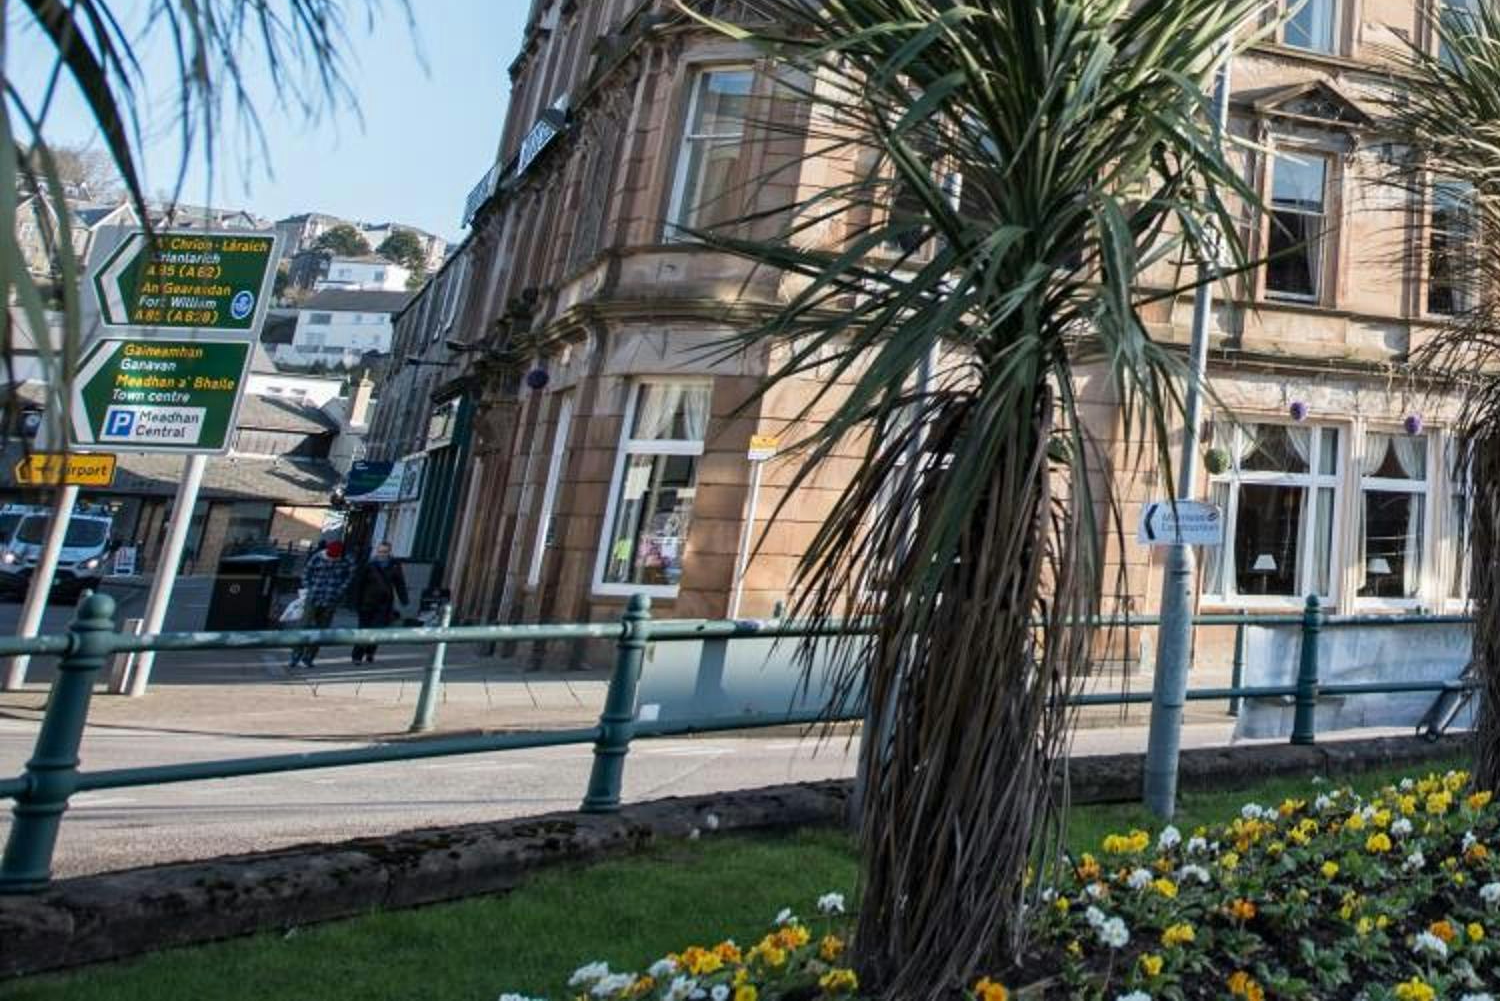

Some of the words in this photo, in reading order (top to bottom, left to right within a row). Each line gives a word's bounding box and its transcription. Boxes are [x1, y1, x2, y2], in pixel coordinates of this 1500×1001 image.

[154, 252, 221, 264] rianlarich
[171, 297, 217, 309] William
[120, 358, 177, 371] Ganavan
[115, 374, 175, 388] Meadhan
[193, 377, 236, 390] Bhaile
[112, 388, 145, 400] Town
[147, 390, 191, 403] centre
[139, 410, 199, 424] Meadhan
[135, 425, 185, 438] Central
